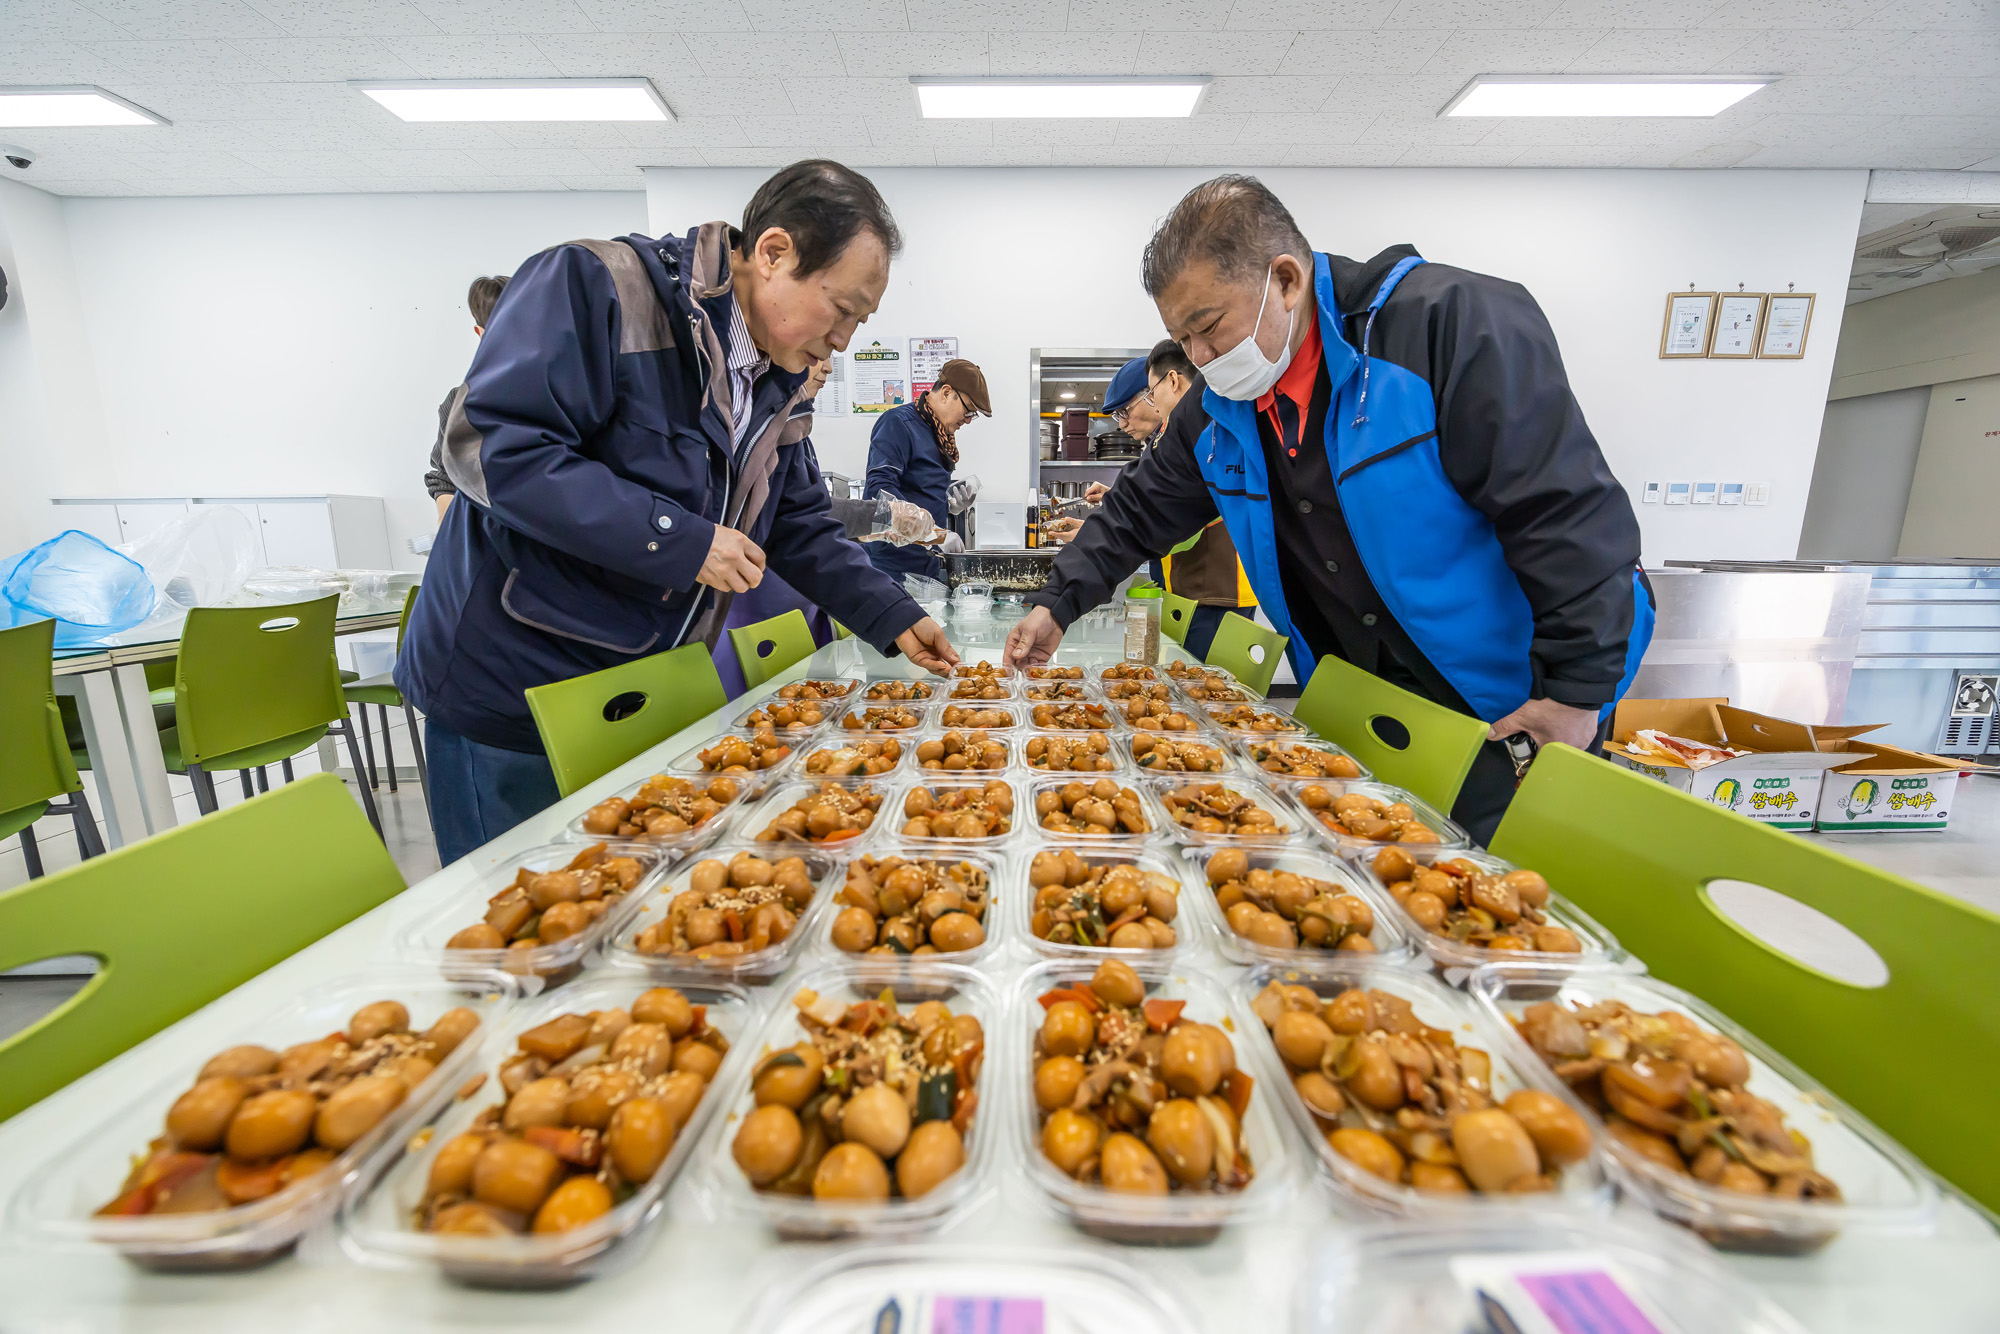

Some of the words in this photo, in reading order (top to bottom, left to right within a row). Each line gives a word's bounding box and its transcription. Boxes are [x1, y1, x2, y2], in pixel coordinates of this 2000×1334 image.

[1226, 465, 1245, 474] FIL
[1749, 791, 1798, 811] 쌈배추
[1887, 791, 1937, 811] 쌈배추
